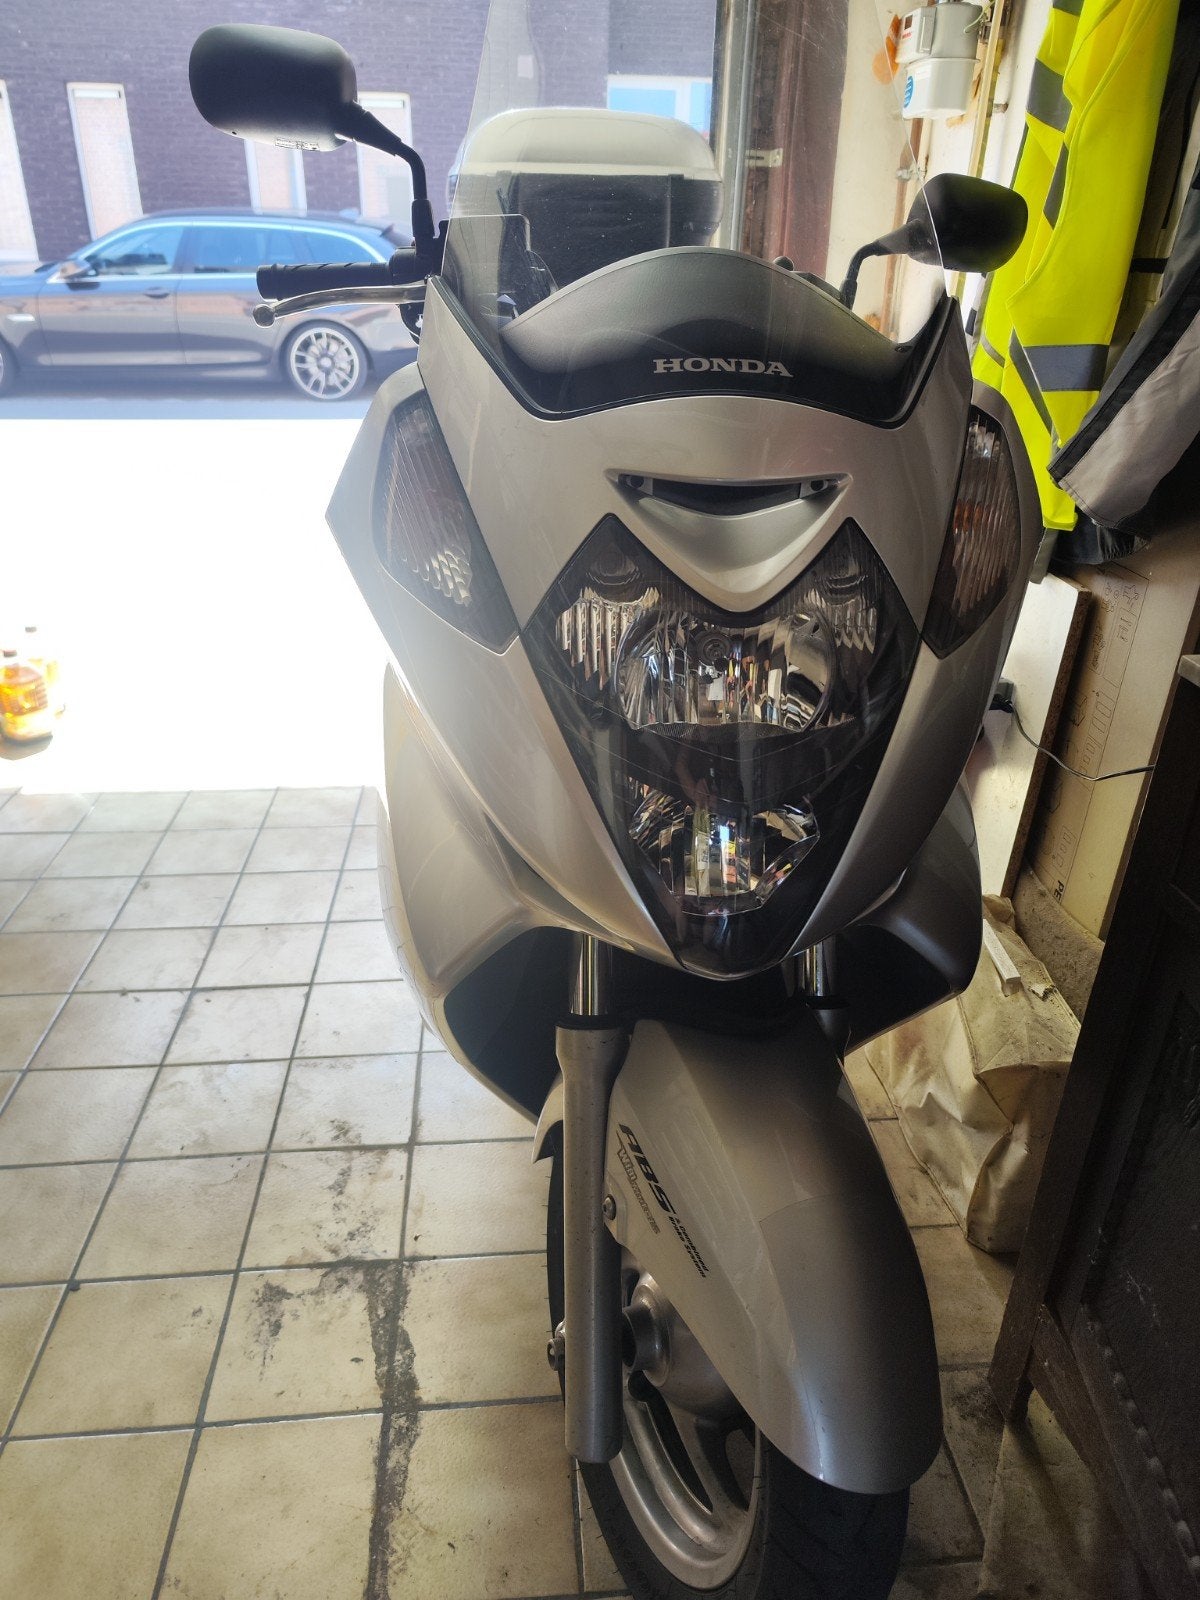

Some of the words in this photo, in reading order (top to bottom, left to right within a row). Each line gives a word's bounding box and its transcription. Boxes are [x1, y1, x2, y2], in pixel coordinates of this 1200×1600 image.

[653, 357, 794, 378] HONDA
[618, 1123, 677, 1214] ABS
[668, 1216, 686, 1242] Brake
[684, 1244, 707, 1278] System
[679, 1225, 710, 1272] Combined
